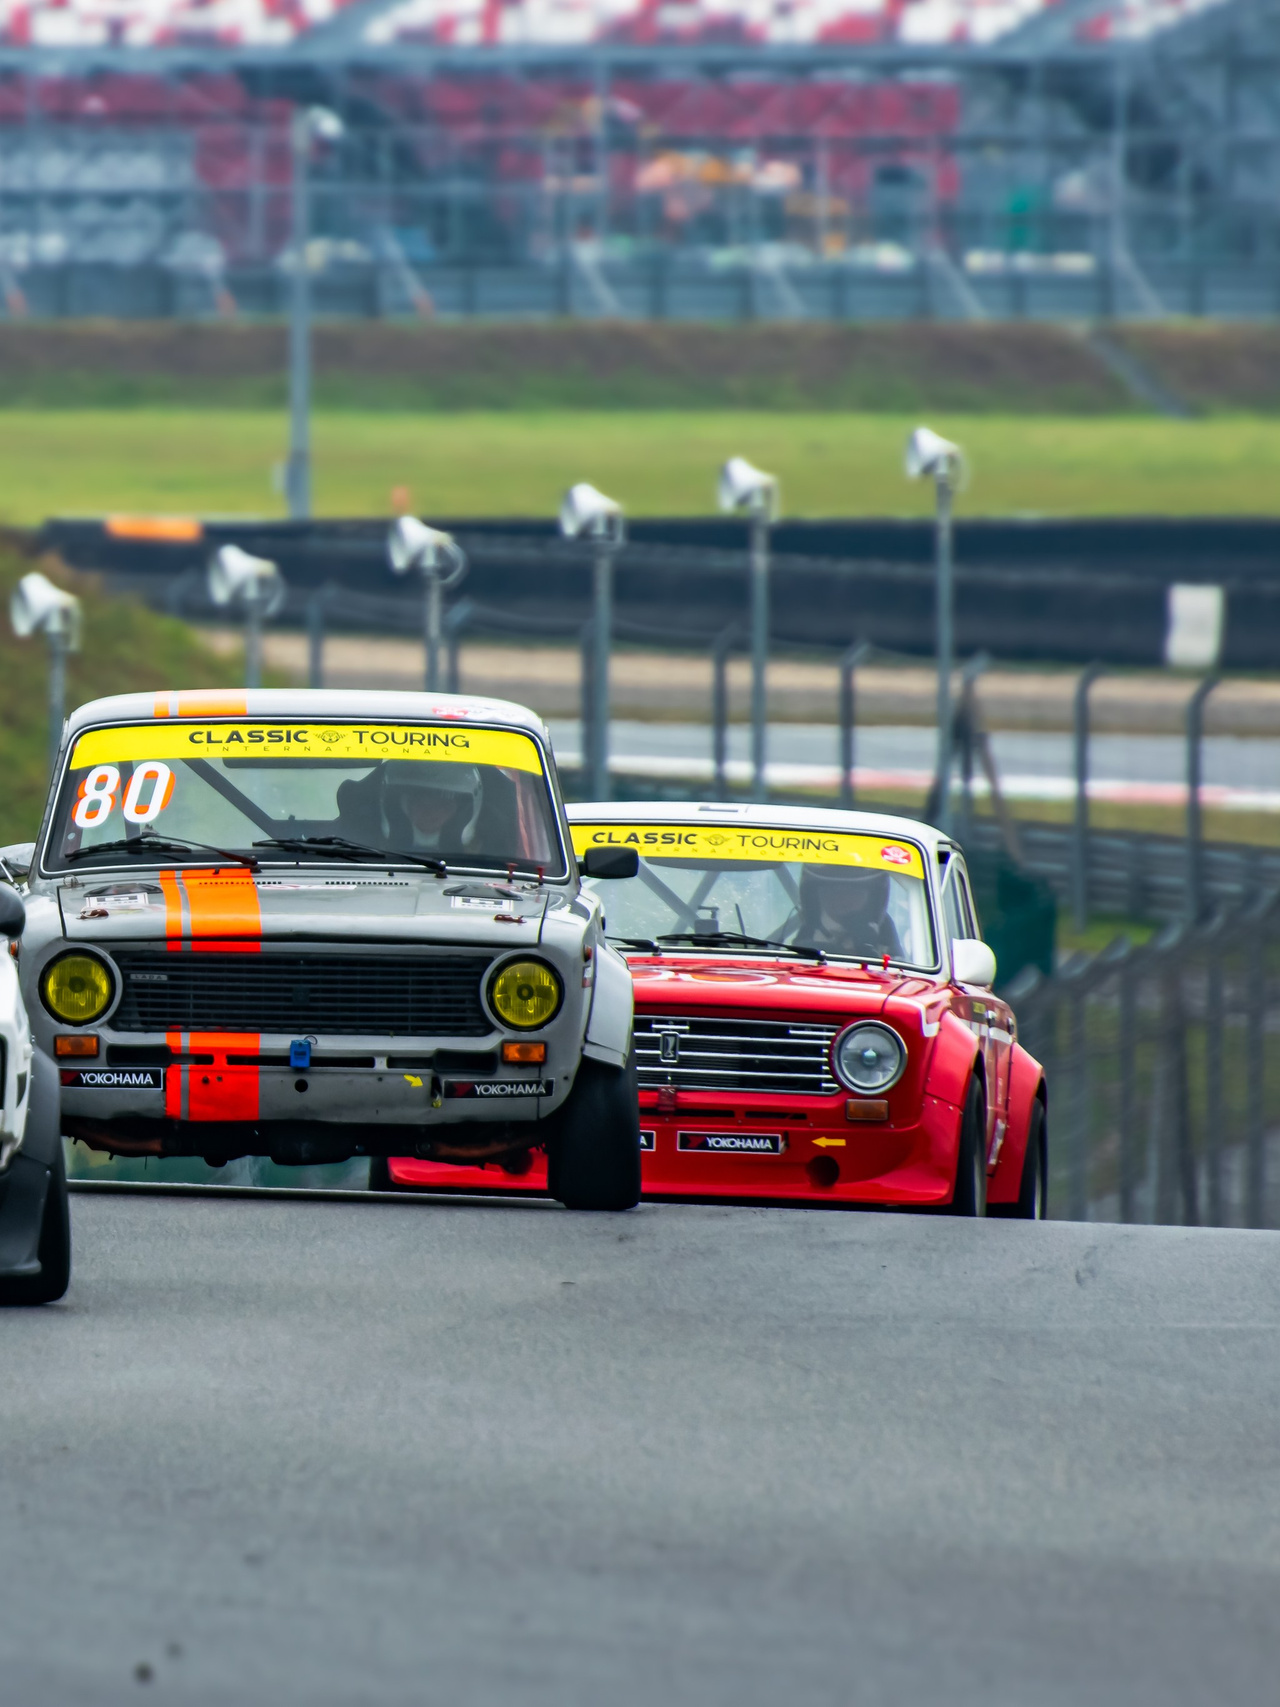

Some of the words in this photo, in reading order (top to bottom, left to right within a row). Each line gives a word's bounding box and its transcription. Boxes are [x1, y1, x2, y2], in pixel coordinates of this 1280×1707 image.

[189, 729, 309, 744] CLASSIC
[353, 730, 470, 748] TOURING
[206, 745, 452, 756] INTERNATIONAL
[71, 761, 176, 828] 80
[592, 832, 697, 845] CLASSIC
[736, 834, 839, 852] TOURING
[639, 846, 822, 858] TERNATIONAL
[80, 1072, 154, 1085] YOKOHAMA
[475, 1083, 546, 1096] YOKOHAMA
[706, 1136, 772, 1150] YOKOHAMA
